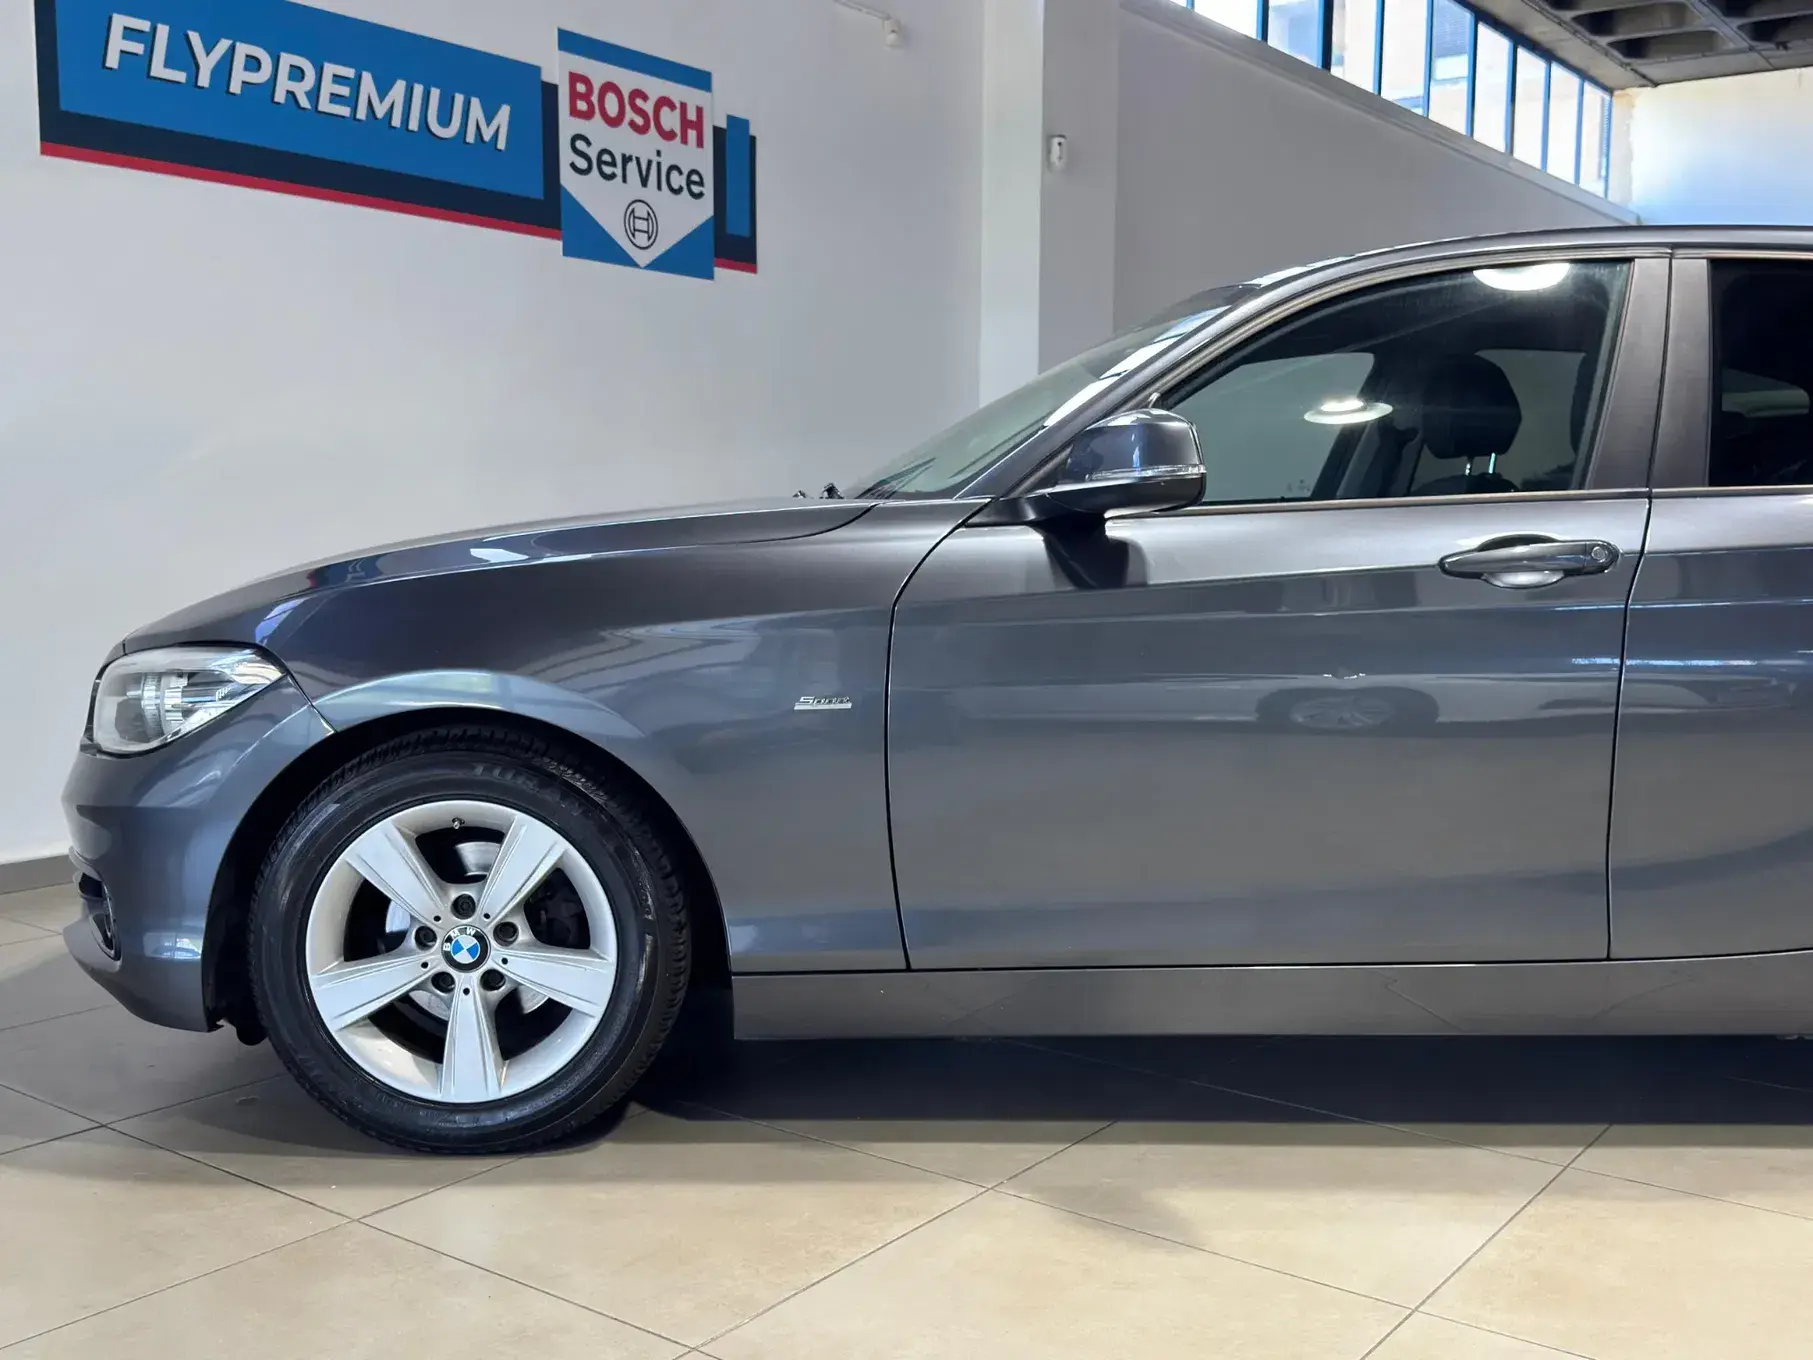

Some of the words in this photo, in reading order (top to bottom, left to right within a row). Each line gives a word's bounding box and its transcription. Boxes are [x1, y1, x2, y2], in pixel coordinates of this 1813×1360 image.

[104, 13, 511, 151] FLYPREMIUM
[568, 71, 705, 149] BOSCH
[569, 133, 706, 200] Service
[442, 926, 477, 952] BMW
